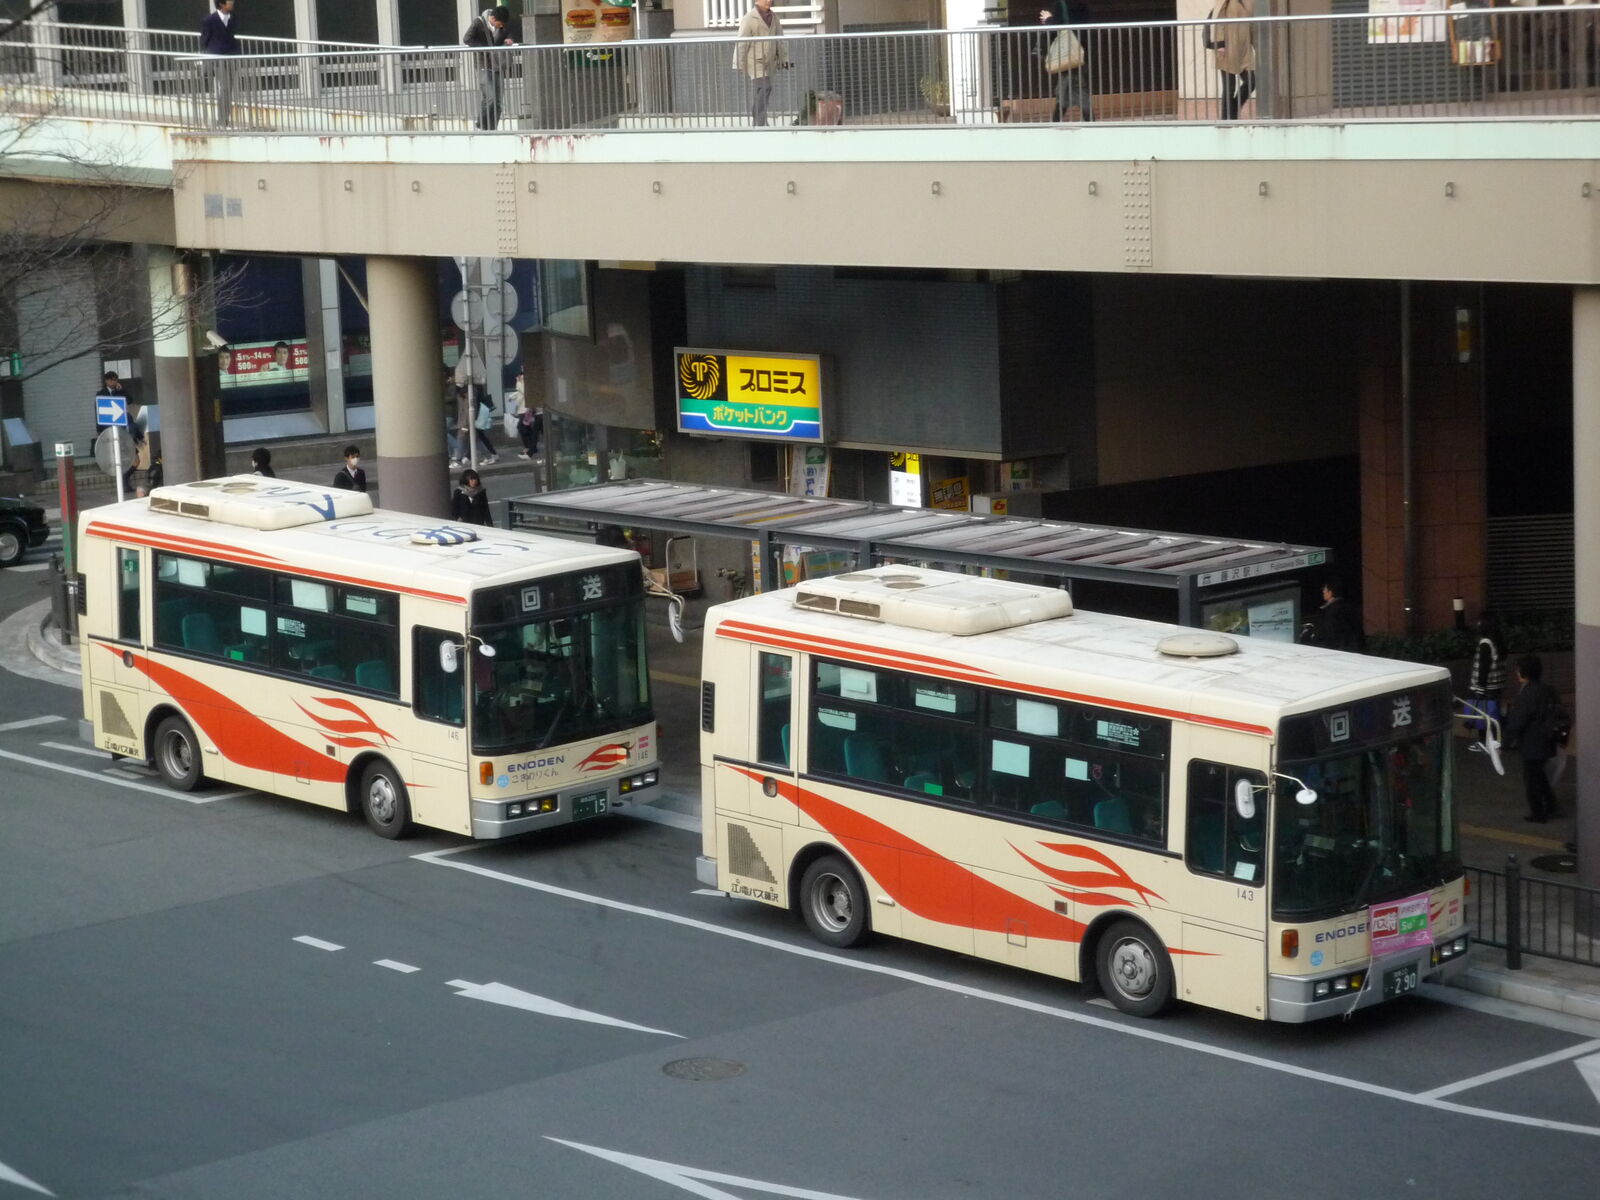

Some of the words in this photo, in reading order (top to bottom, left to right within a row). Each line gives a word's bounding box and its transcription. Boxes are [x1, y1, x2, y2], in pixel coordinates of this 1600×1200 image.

[739, 368, 807, 395] プロミス
[712, 404, 788, 426] ポケットバンク
[507, 755, 565, 773] ENODEN
[1237, 888, 1254, 902] 143
